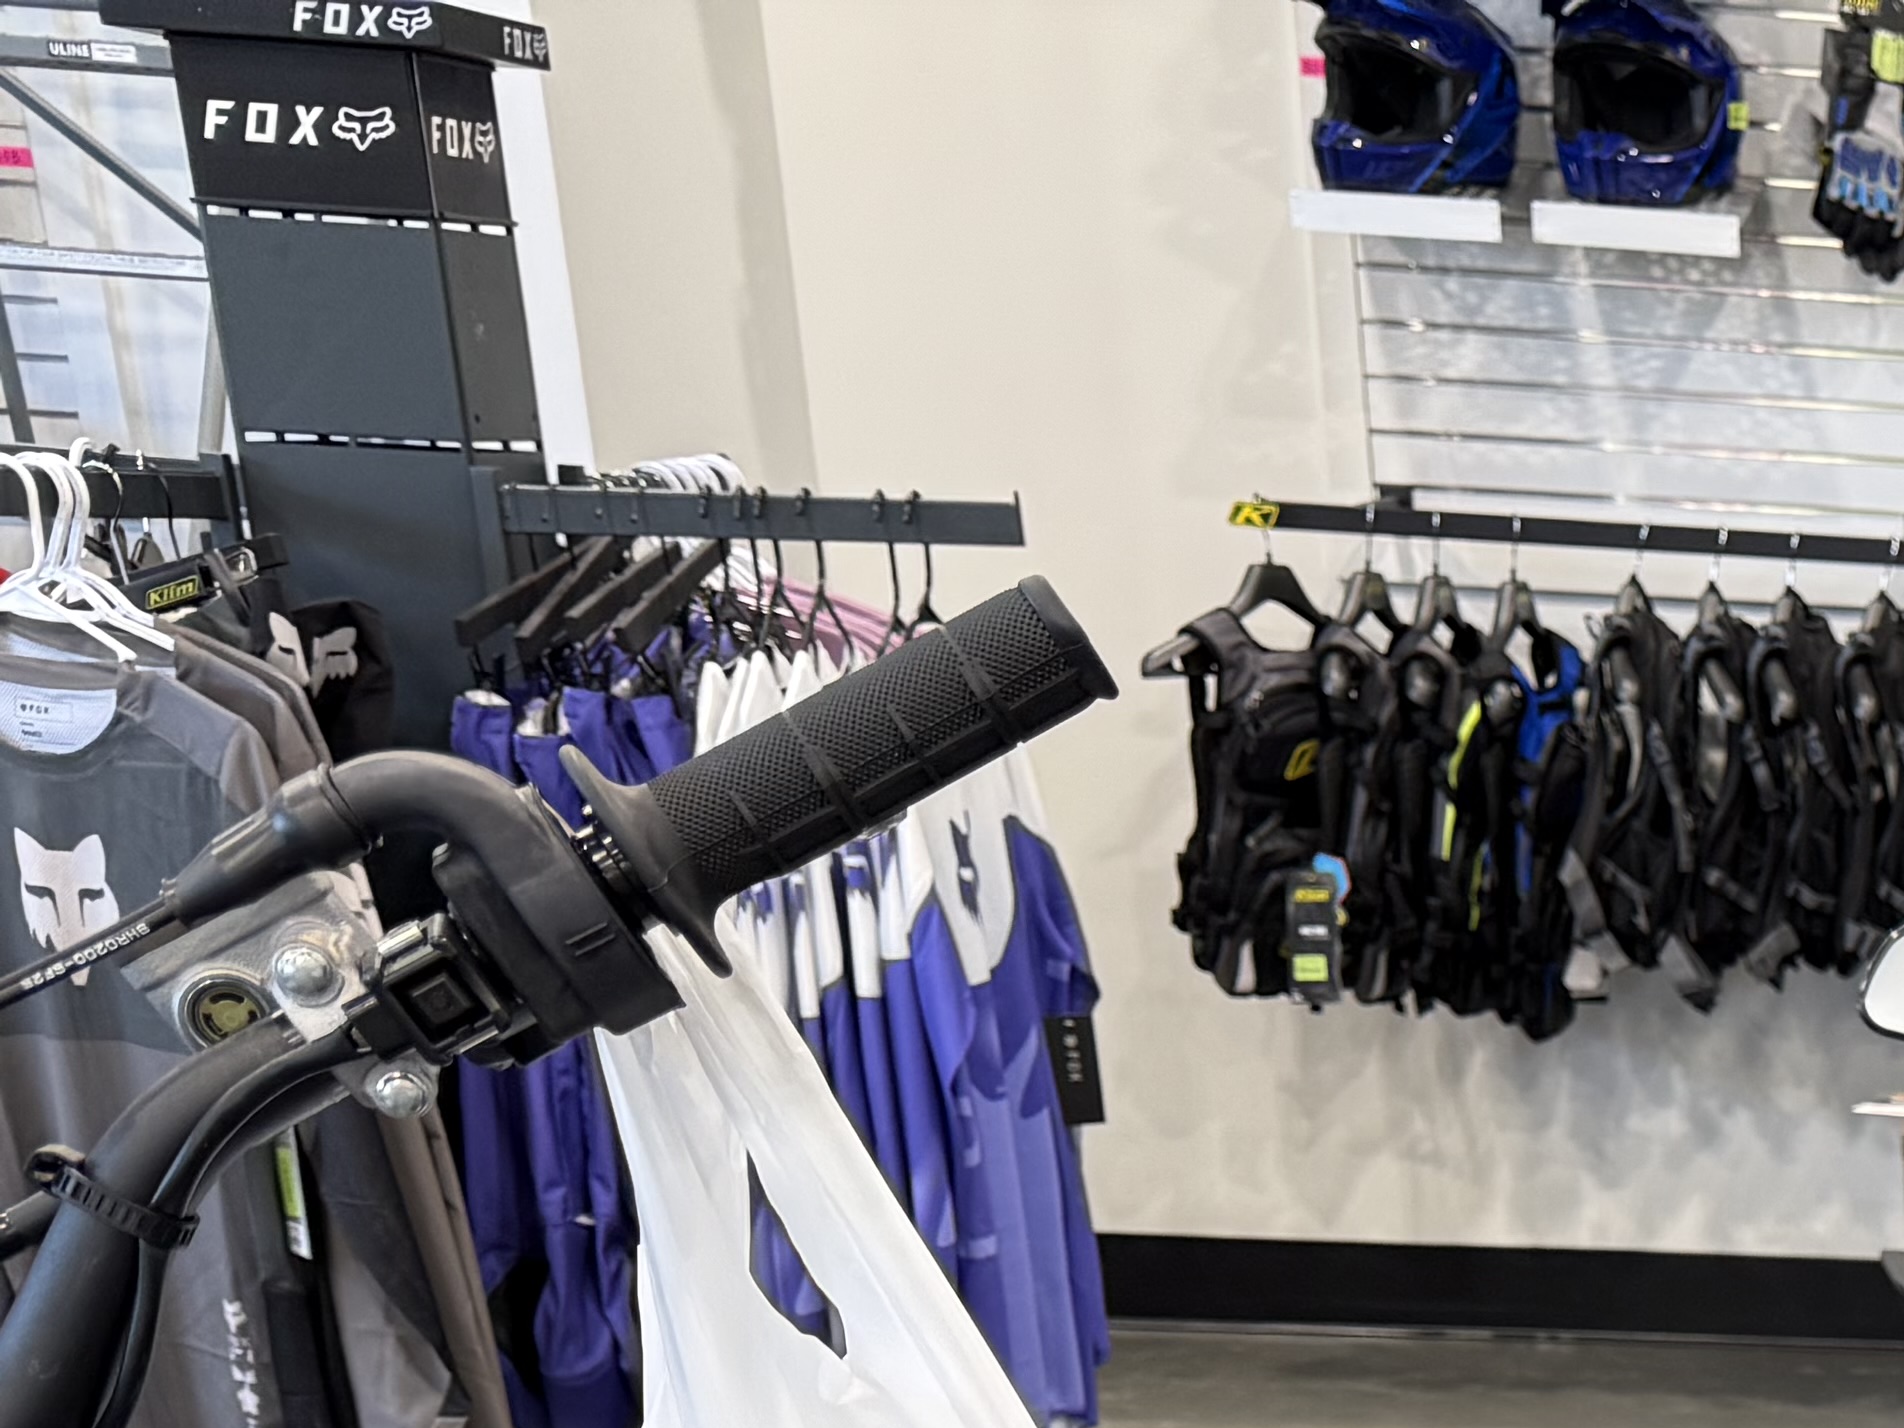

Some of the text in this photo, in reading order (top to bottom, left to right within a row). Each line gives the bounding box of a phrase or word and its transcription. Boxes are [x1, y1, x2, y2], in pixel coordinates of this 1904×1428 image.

[292, 0, 383, 37] FOX
[49, 42, 91, 57] ULINE
[503, 26, 533, 60] FOX
[203, 99, 324, 146] FOX
[431, 116, 474, 160] FOX
